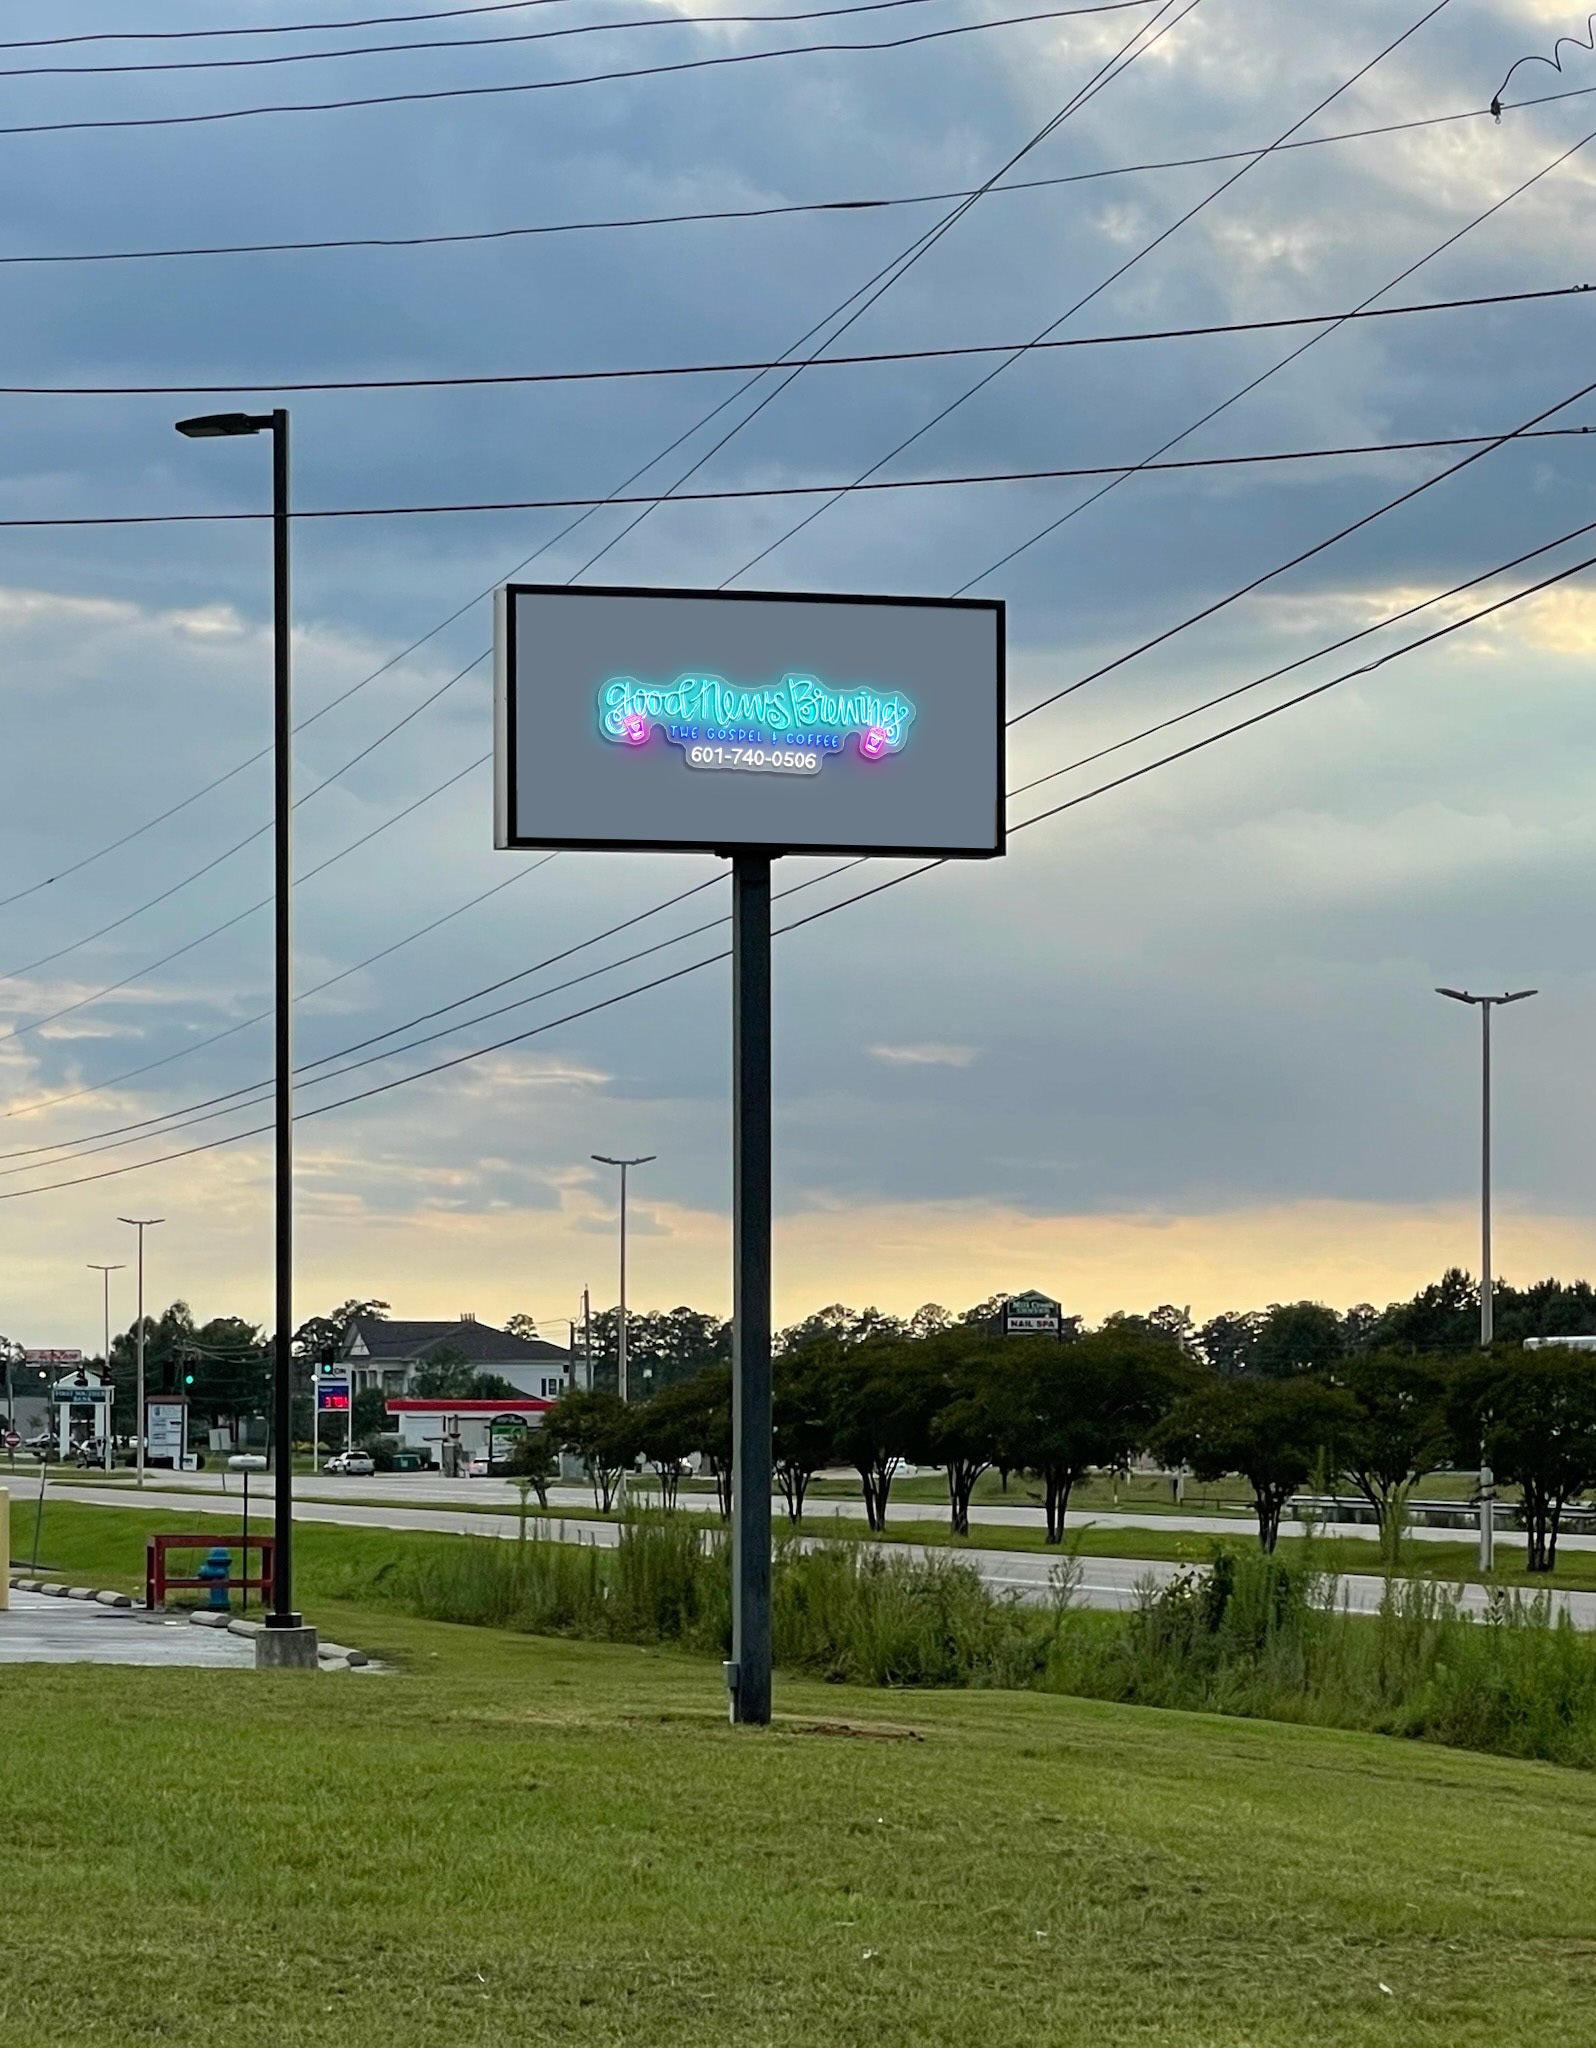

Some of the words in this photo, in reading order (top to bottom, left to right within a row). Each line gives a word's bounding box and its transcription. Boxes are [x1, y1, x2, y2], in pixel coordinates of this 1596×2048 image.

[788, 679, 909, 745] Brewing
[670, 725, 698, 740] THE
[707, 727, 763, 743] GOSPEL
[786, 733, 839, 748] COFFEE
[691, 746, 817, 769] 601-740-0506
[1010, 1320, 1034, 1328] NAIL
[1036, 1320, 1055, 1328] SPA
